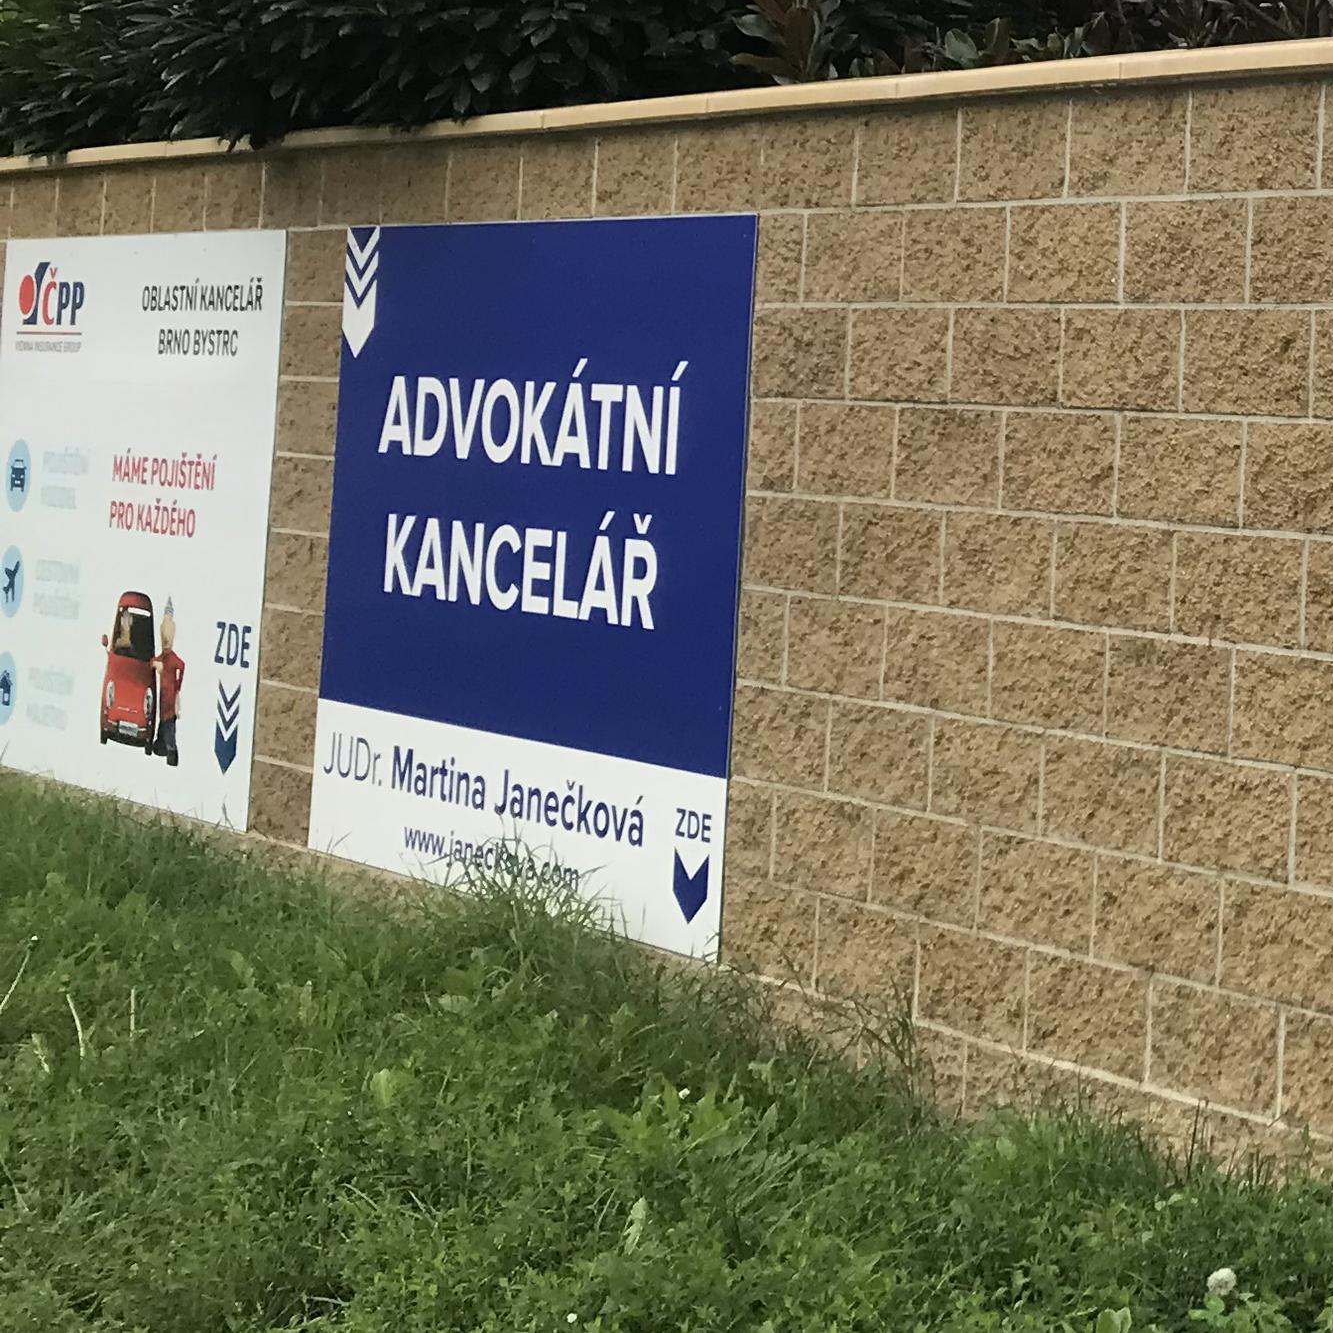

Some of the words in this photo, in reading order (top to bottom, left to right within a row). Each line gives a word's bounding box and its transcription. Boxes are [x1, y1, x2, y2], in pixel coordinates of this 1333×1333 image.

[42, 266, 85, 325] ČPP
[142, 277, 199, 311] OBLASTNÍ
[200, 277, 263, 312] KANCELÁŘ
[158, 329, 190, 356] BRNO
[193, 329, 239, 357] BYSTRC
[378, 358, 688, 475] ADVOKÁTNÍ
[112, 448, 148, 485] MÁME
[151, 452, 217, 491] POJIŠTĚNÍ
[109, 500, 134, 531] PRO
[137, 498, 196, 538] KAŽDÉHO
[383, 511, 658, 630] KANCELÁŘ
[214, 621, 252, 669] ZDE
[322, 731, 382, 786] JUDr.
[391, 745, 486, 810] Martina
[494, 769, 644, 847] Janečková
[675, 808, 712, 844] ZDE
